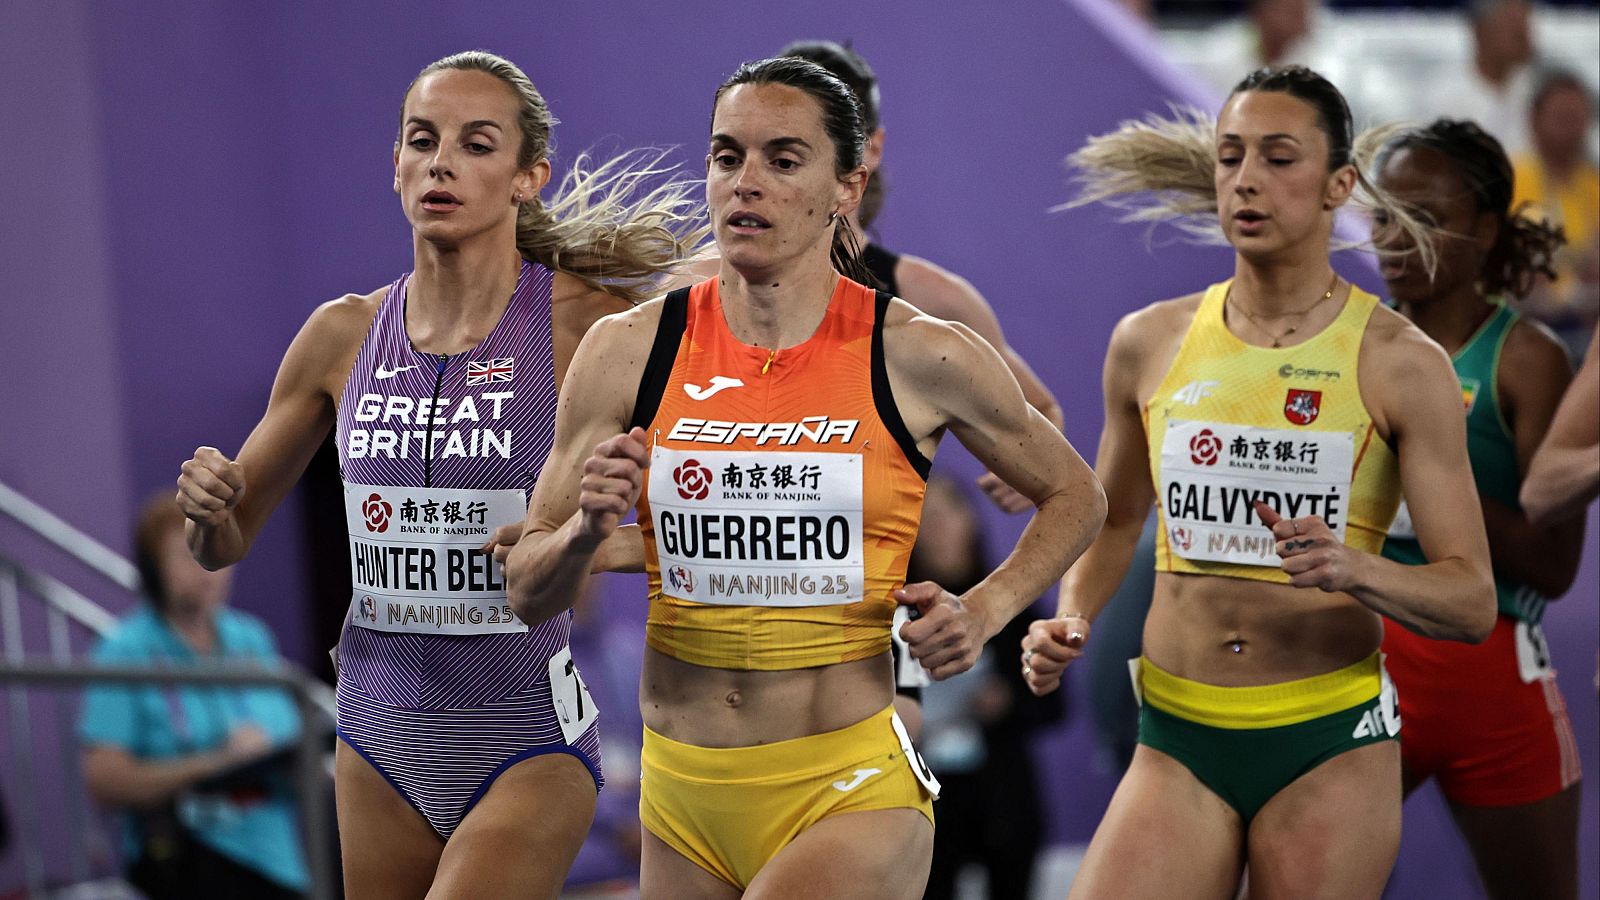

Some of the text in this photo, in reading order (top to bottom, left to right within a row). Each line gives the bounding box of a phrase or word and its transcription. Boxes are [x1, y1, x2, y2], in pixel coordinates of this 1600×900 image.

[1172, 380, 1220, 406] 4F
[355, 391, 514, 425] GREAT
[349, 429, 512, 460] BRITAIN
[667, 416, 859, 446] ESPAÑA
[1229, 435, 1319, 465] 南京银行
[721, 462, 822, 490] 南京银行
[1229, 460, 1254, 469] BANK
[1275, 465, 1318, 475] NANJING
[723, 491, 821, 502] BANK OF NANJING
[400, 498, 489, 525] 南京银行
[400, 525, 488, 536] BANK OF NANJING
[660, 510, 850, 561] GUERRERO
[1207, 532, 1276, 560] NANJI
[354, 541, 508, 592] HUNTER BEL
[709, 573, 849, 599] NANJING 25
[387, 603, 514, 628] NANJING 25
